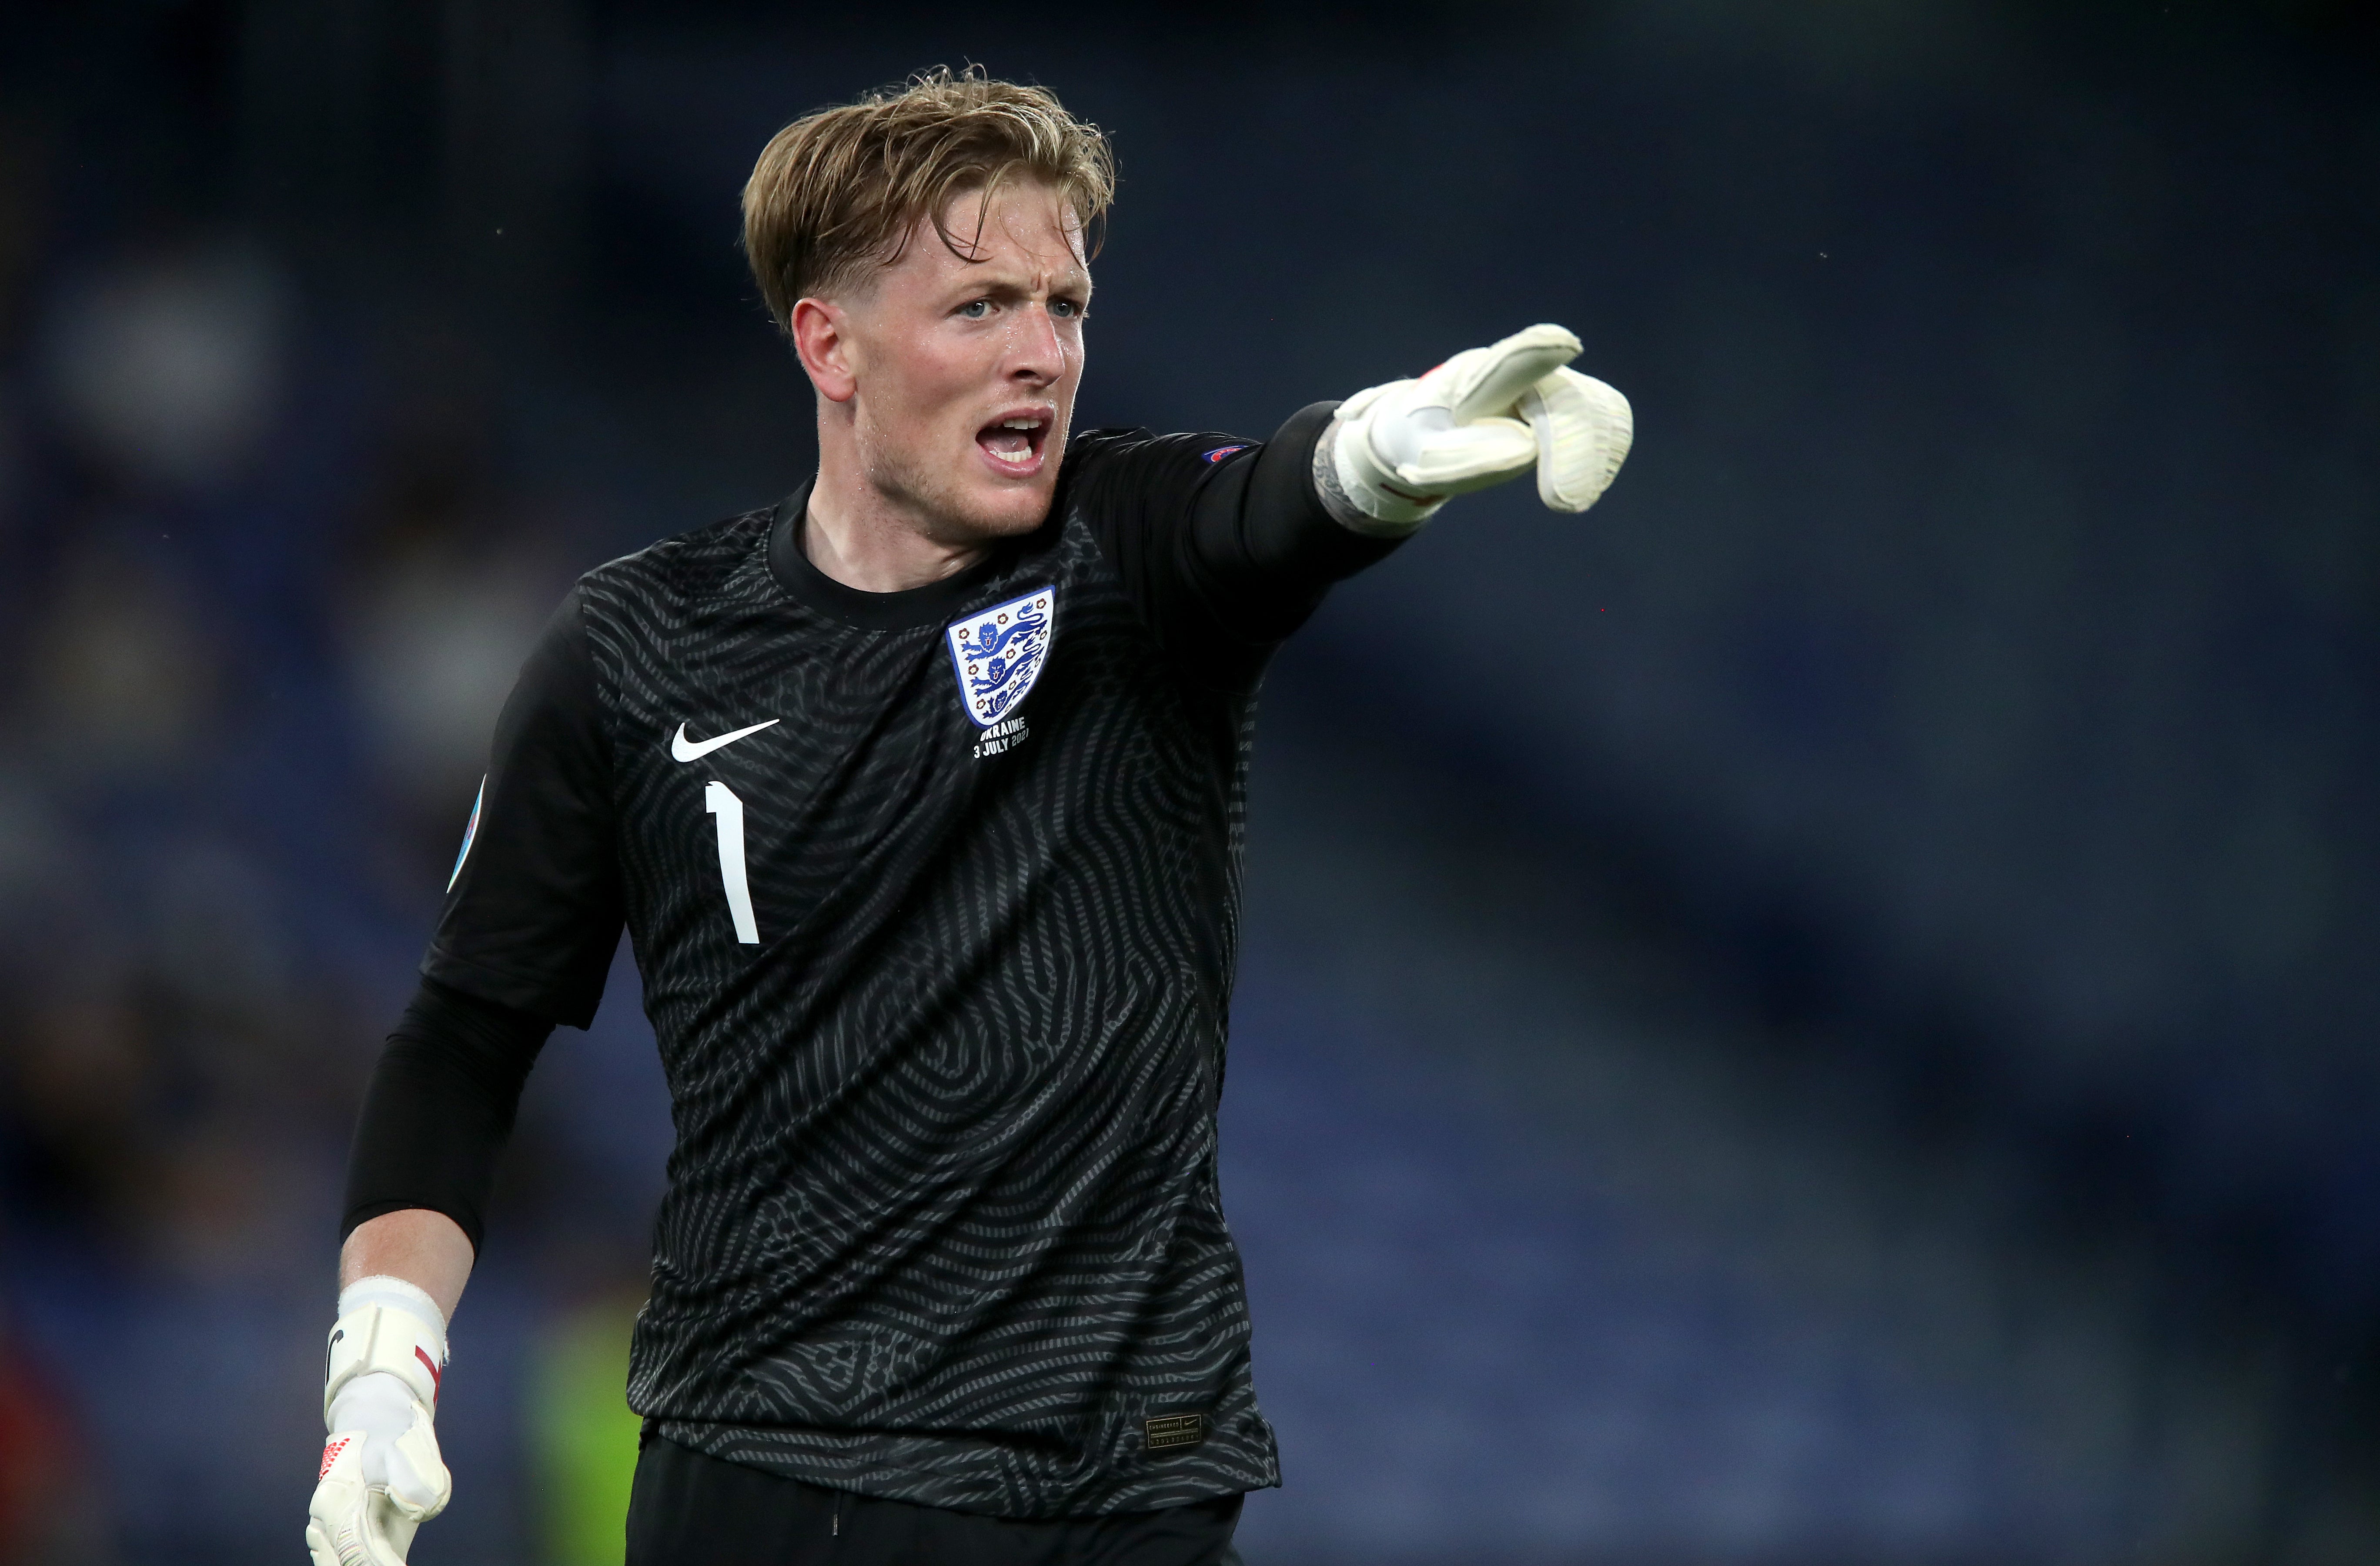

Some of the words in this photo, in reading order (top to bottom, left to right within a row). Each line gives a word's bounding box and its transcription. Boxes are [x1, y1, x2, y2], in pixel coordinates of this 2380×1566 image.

[980, 716, 1025, 742] UKRAINE
[973, 745, 980, 759] 3
[983, 738, 1008, 756] JULY
[1012, 728, 1029, 747] 2021
[705, 780, 760, 944] 1
[1149, 1422, 1179, 1431] ENGINEERED
